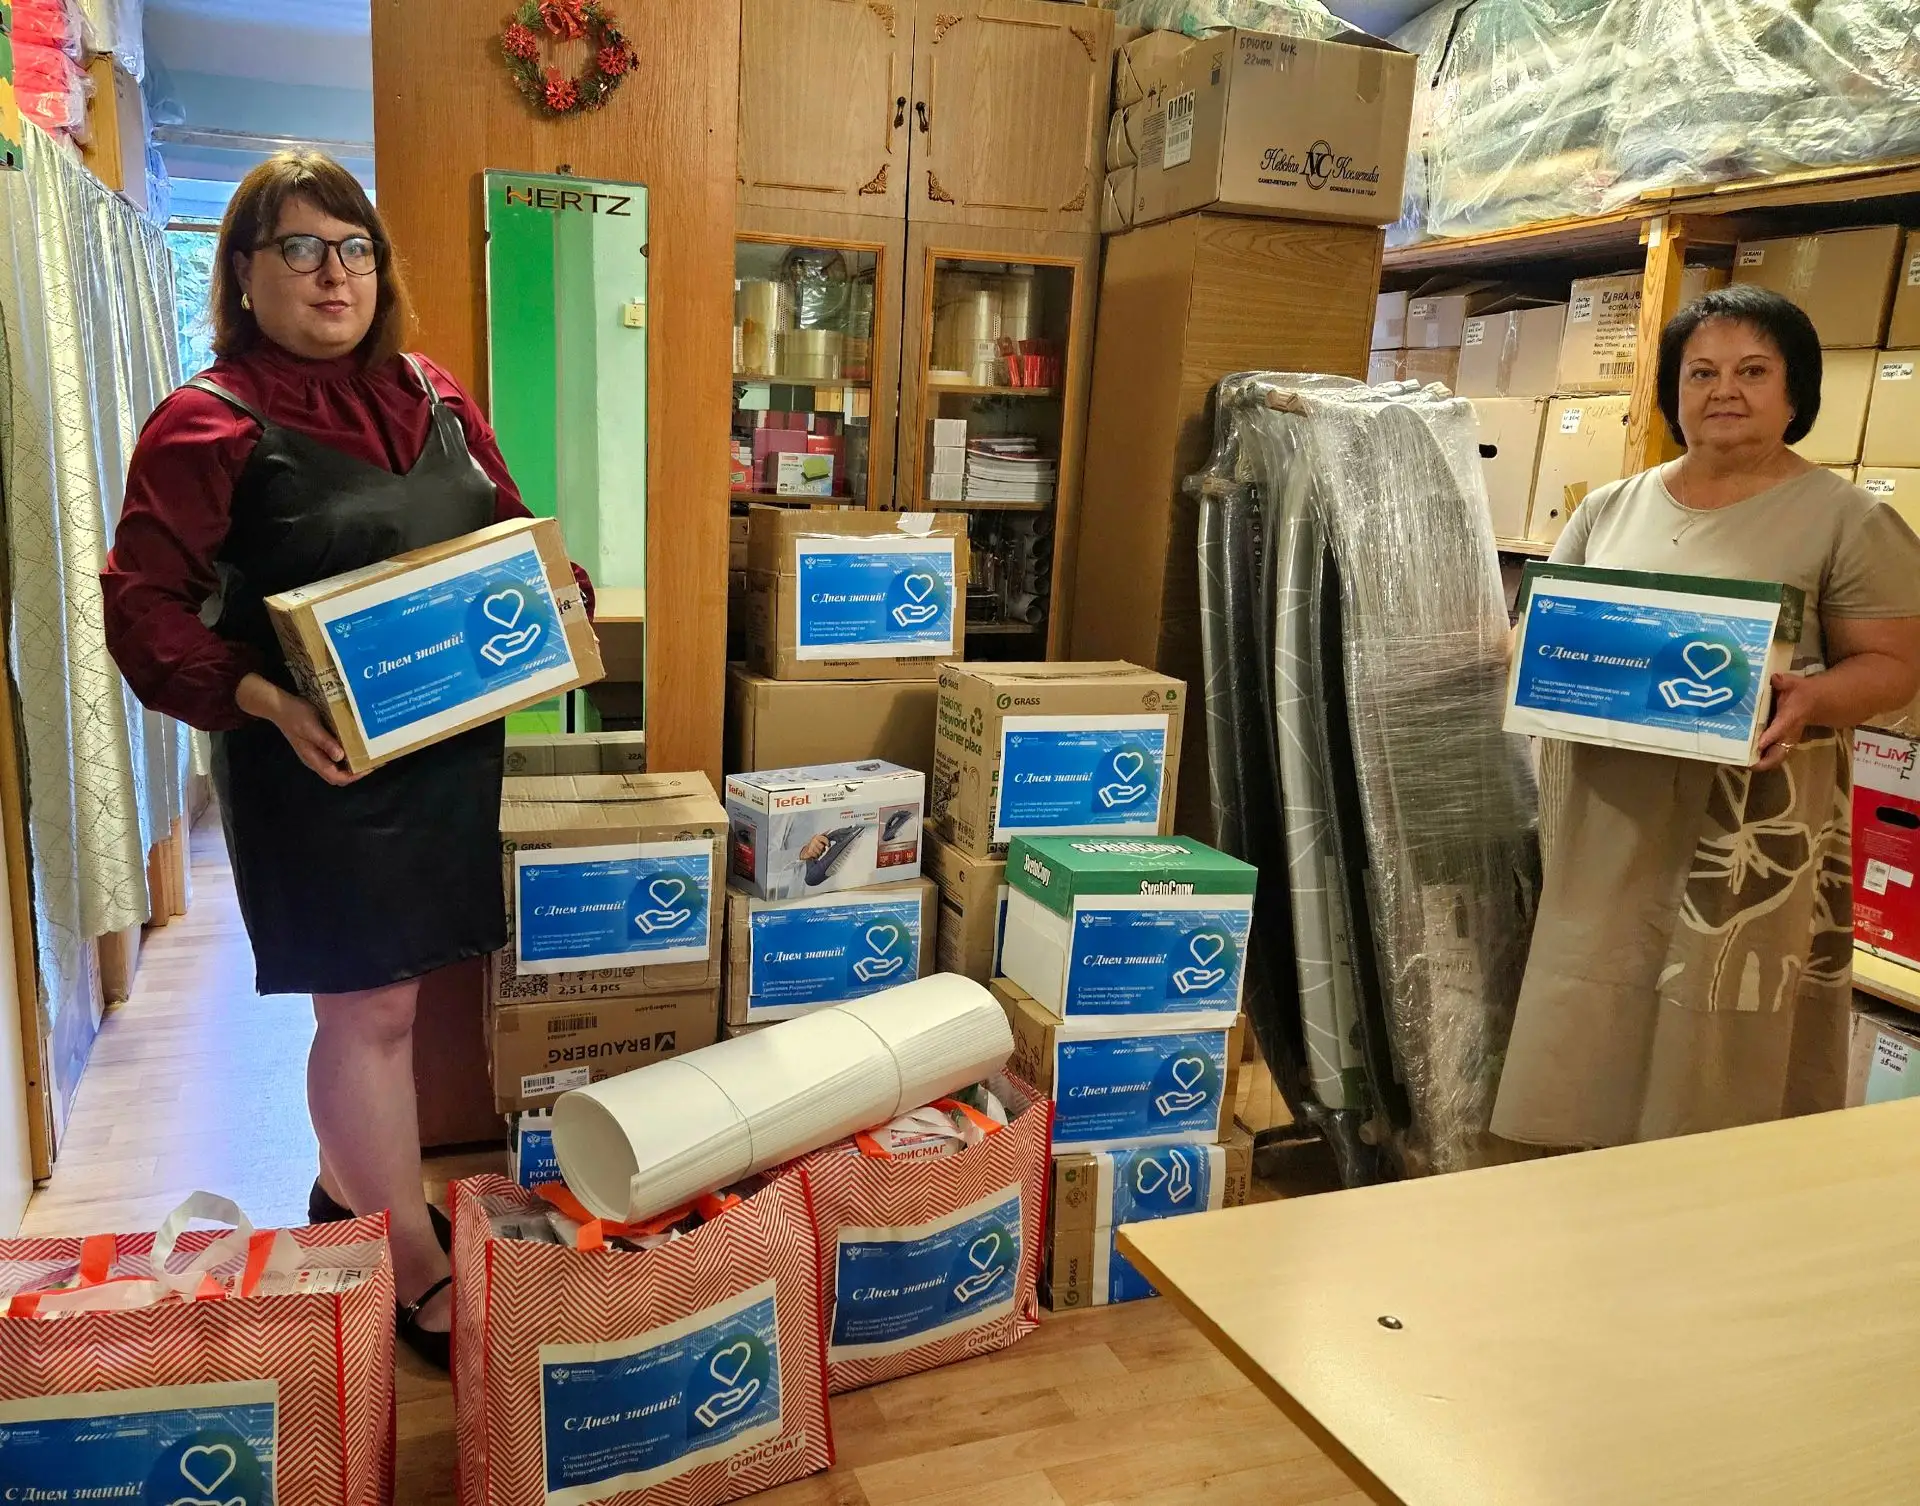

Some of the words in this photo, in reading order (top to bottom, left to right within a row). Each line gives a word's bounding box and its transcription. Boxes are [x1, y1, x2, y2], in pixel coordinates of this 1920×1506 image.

[1168, 92, 1194, 120] 01016
[506, 186, 631, 216] HERTZ
[811, 593, 820, 603] С
[820, 593, 846, 604] Днем
[848, 592, 886, 602] знаний!
[363, 666, 374, 679] С
[376, 655, 412, 677] Днем
[414, 631, 464, 660] знаний!
[1538, 644, 1551, 656] С
[1549, 646, 1589, 661] Днем
[1592, 654, 1651, 669] знаний!
[1014, 698, 1041, 706] GRASS
[965, 736, 982, 756] place
[1014, 773, 1023, 783] С
[1023, 772, 1051, 785] Днем
[1054, 772, 1093, 783] знаний!
[728, 784, 746, 799] Tefal
[774, 795, 812, 808] Tefal
[521, 843, 552, 852] GRASS
[1024, 853, 1051, 887] SvetoCopy
[534, 906, 544, 916] С
[544, 905, 577, 917] Днем
[580, 900, 626, 913] знаний!
[764, 952, 773, 962] С
[773, 951, 802, 964] Днем
[805, 946, 846, 959] знаний!
[1083, 955, 1093, 966] С
[1091, 954, 1122, 968] Днем
[1124, 953, 1167, 965] знаний!
[590, 984, 598, 993] 4
[600, 984, 620, 994] pcs
[548, 1037, 650, 1064] BRAUBERG
[1068, 1087, 1079, 1097] С
[1077, 1086, 1108, 1099] Днем
[1110, 1081, 1152, 1094] знаний!
[1069, 1258, 1078, 1287] GRASS
[852, 1288, 864, 1301] С
[863, 1287, 900, 1301] Днем
[902, 1272, 948, 1295] знаний!
[564, 1417, 577, 1431] С
[577, 1413, 620, 1432] Днем
[624, 1391, 683, 1420] знаний!
[731, 1435, 802, 1472] ОФИСМАГ
[5, 1487, 19, 1501] С
[21, 1487, 67, 1503] Днем
[72, 1480, 143, 1499] знаний!
